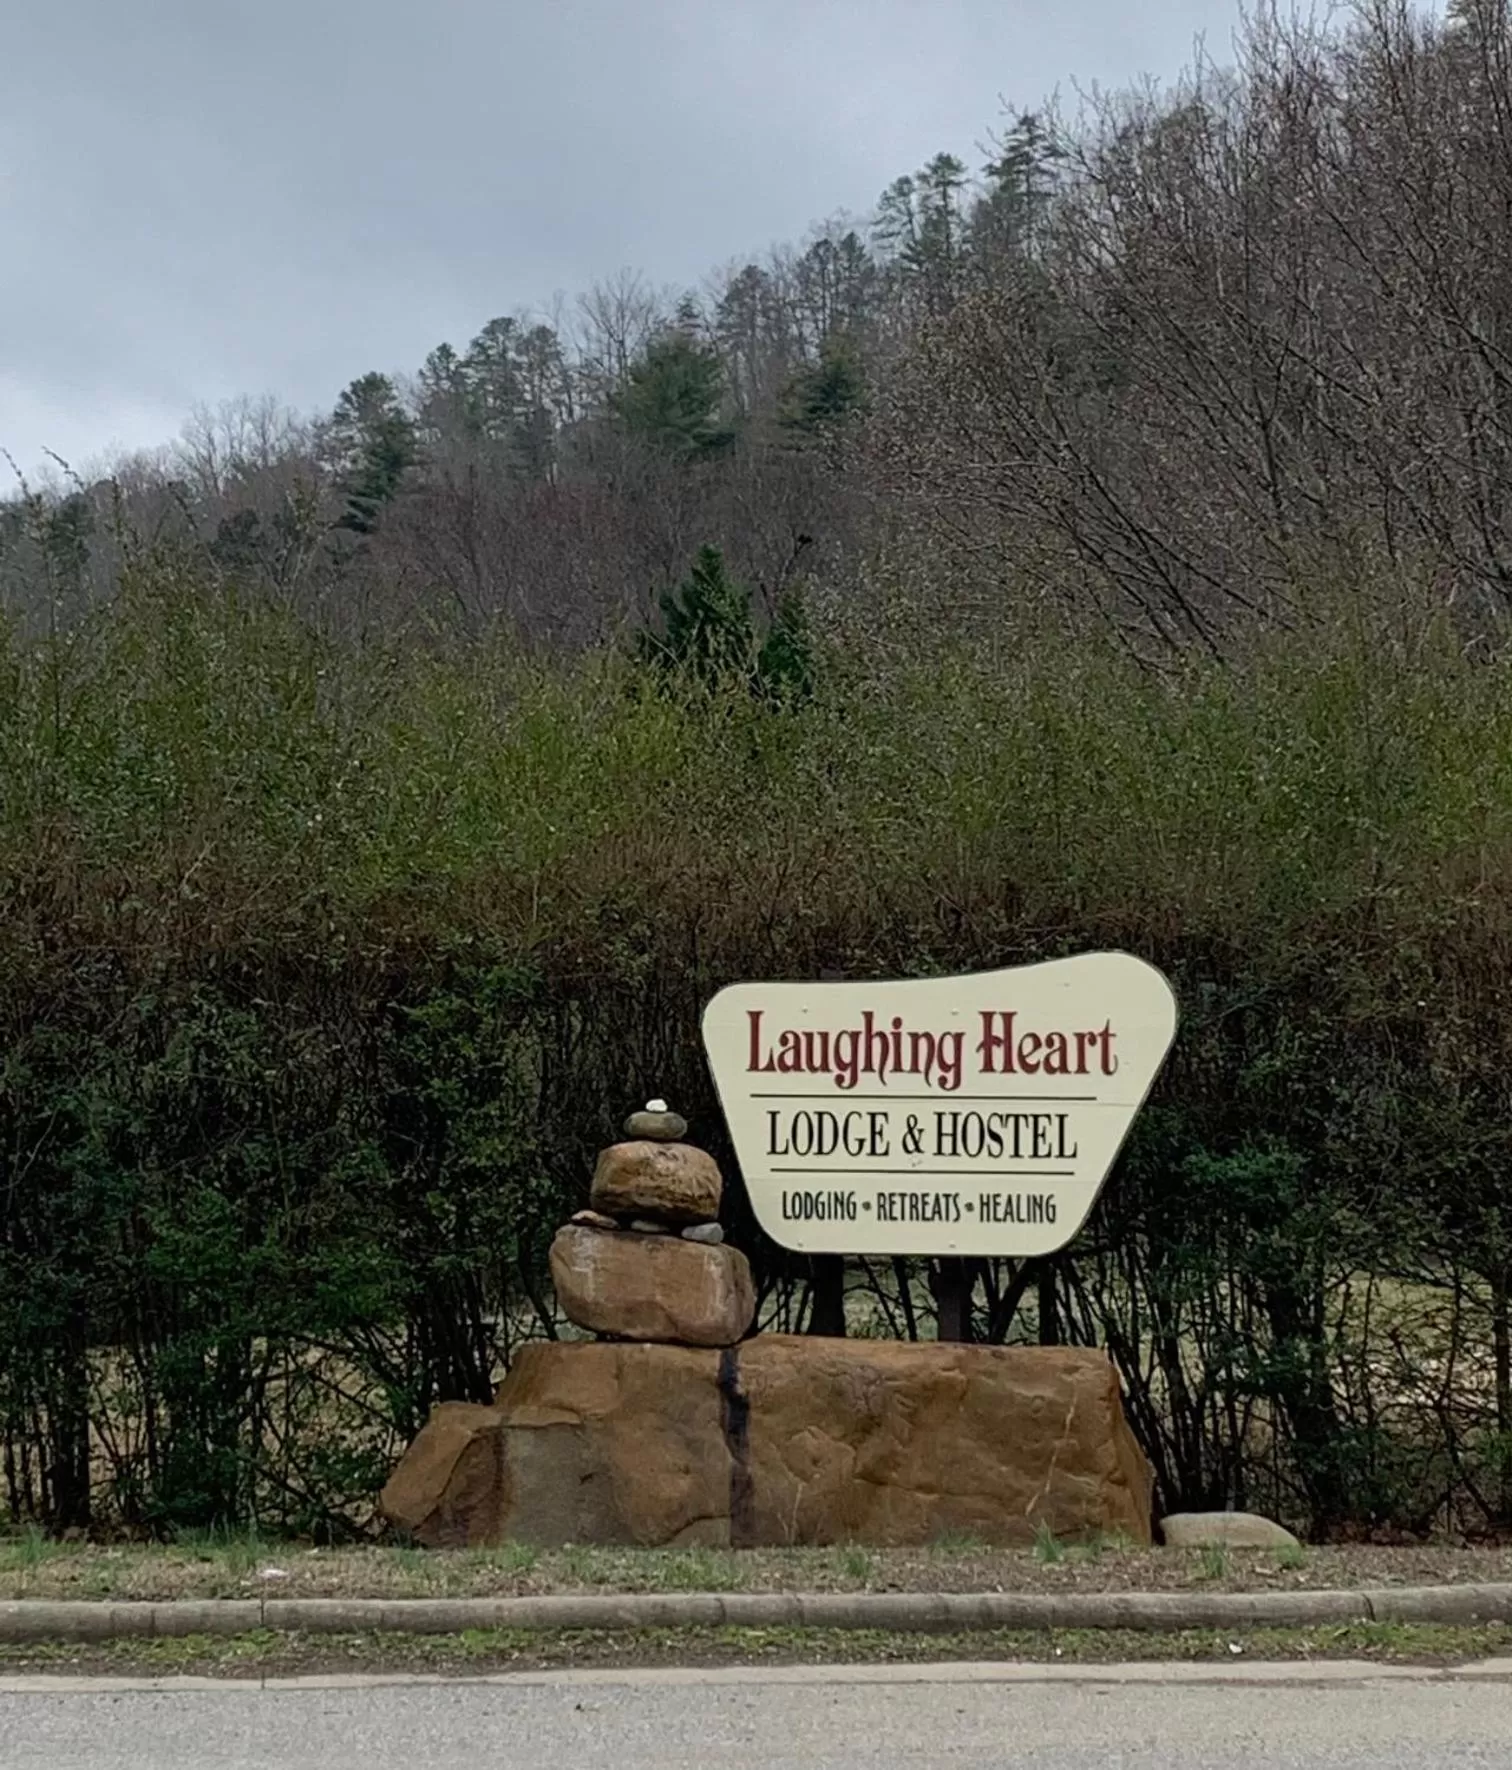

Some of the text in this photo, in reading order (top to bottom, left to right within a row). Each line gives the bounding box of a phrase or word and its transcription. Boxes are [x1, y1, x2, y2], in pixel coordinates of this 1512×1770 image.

[746, 1010, 1118, 1091] Laughing Heart
[766, 1110, 1078, 1159] LODGE & HOSTEL
[782, 1191, 1056, 1224] LODGING RETREATS HEALING
